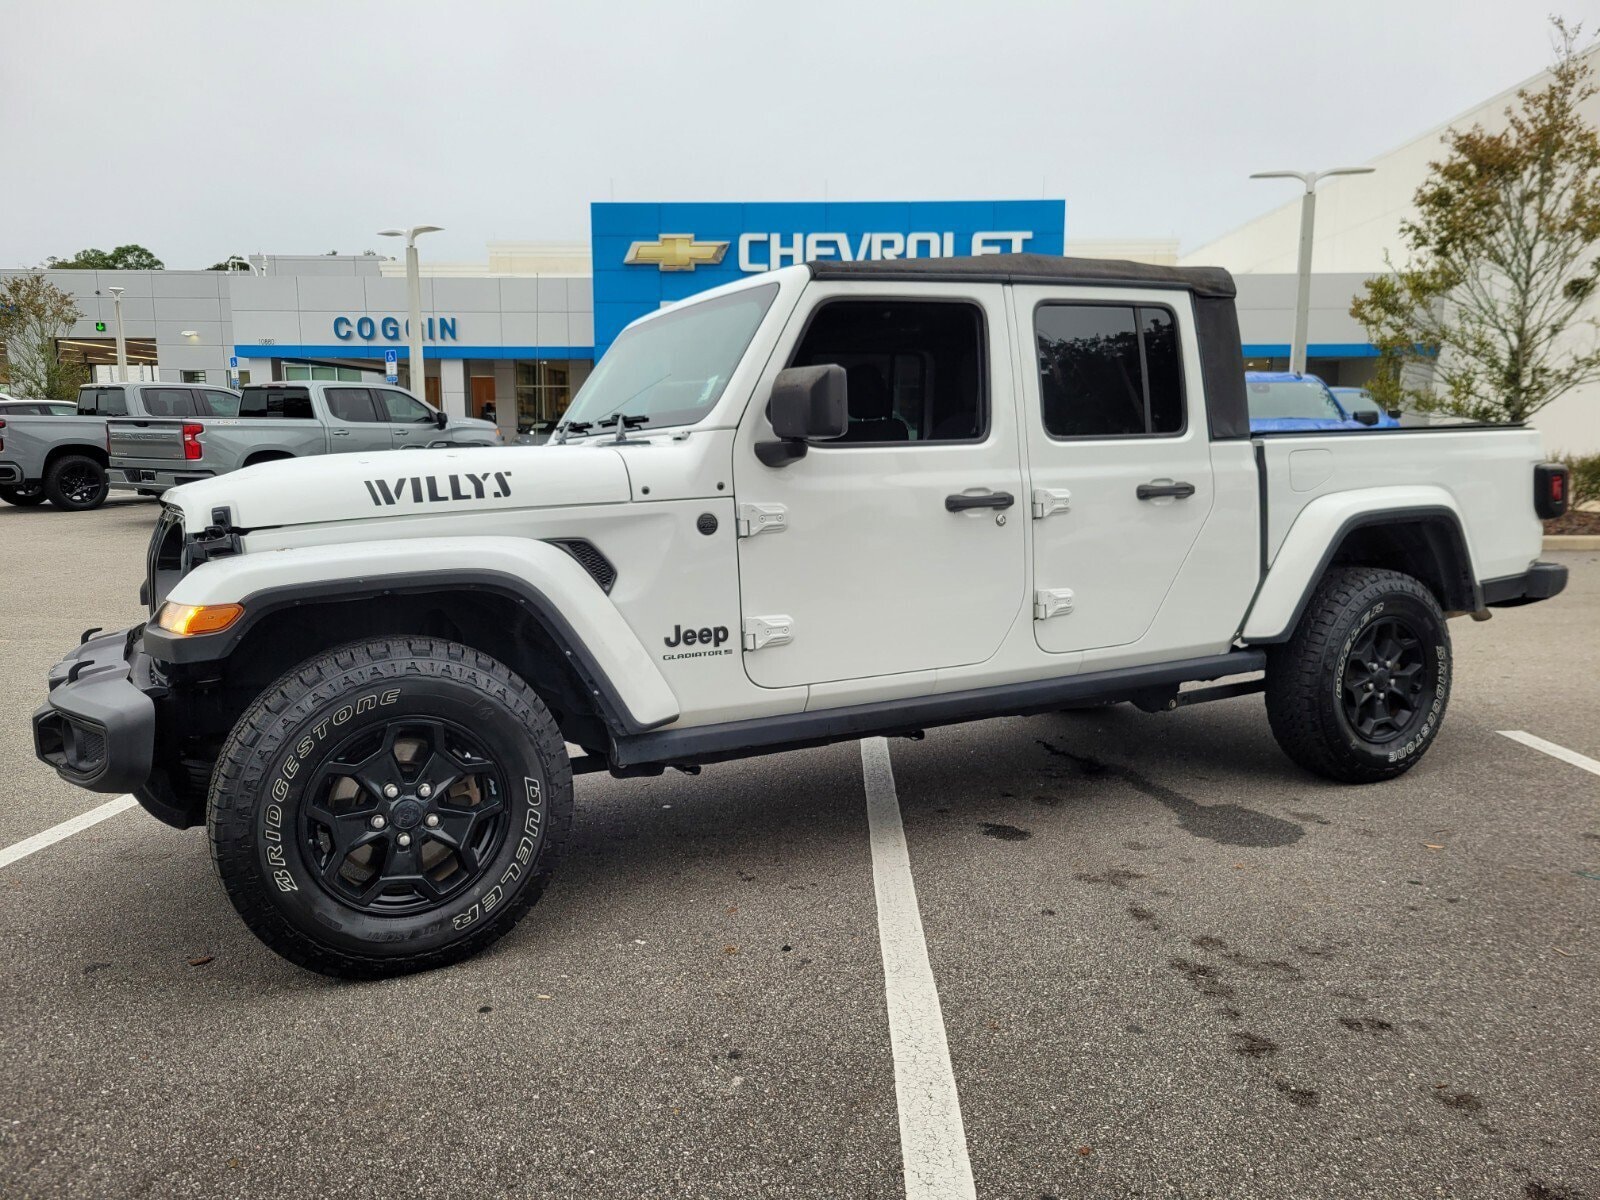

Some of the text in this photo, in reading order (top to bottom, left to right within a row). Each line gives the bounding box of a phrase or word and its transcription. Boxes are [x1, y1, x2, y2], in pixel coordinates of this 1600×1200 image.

[364, 471, 512, 506] WILLYS
[662, 649, 722, 661] GLADIATOR
[663, 624, 729, 648] Jeep
[1388, 645, 1449, 763] BRIDGESTONE
[263, 688, 402, 893] BRIDGESTONE
[452, 776, 542, 931] DUELER
